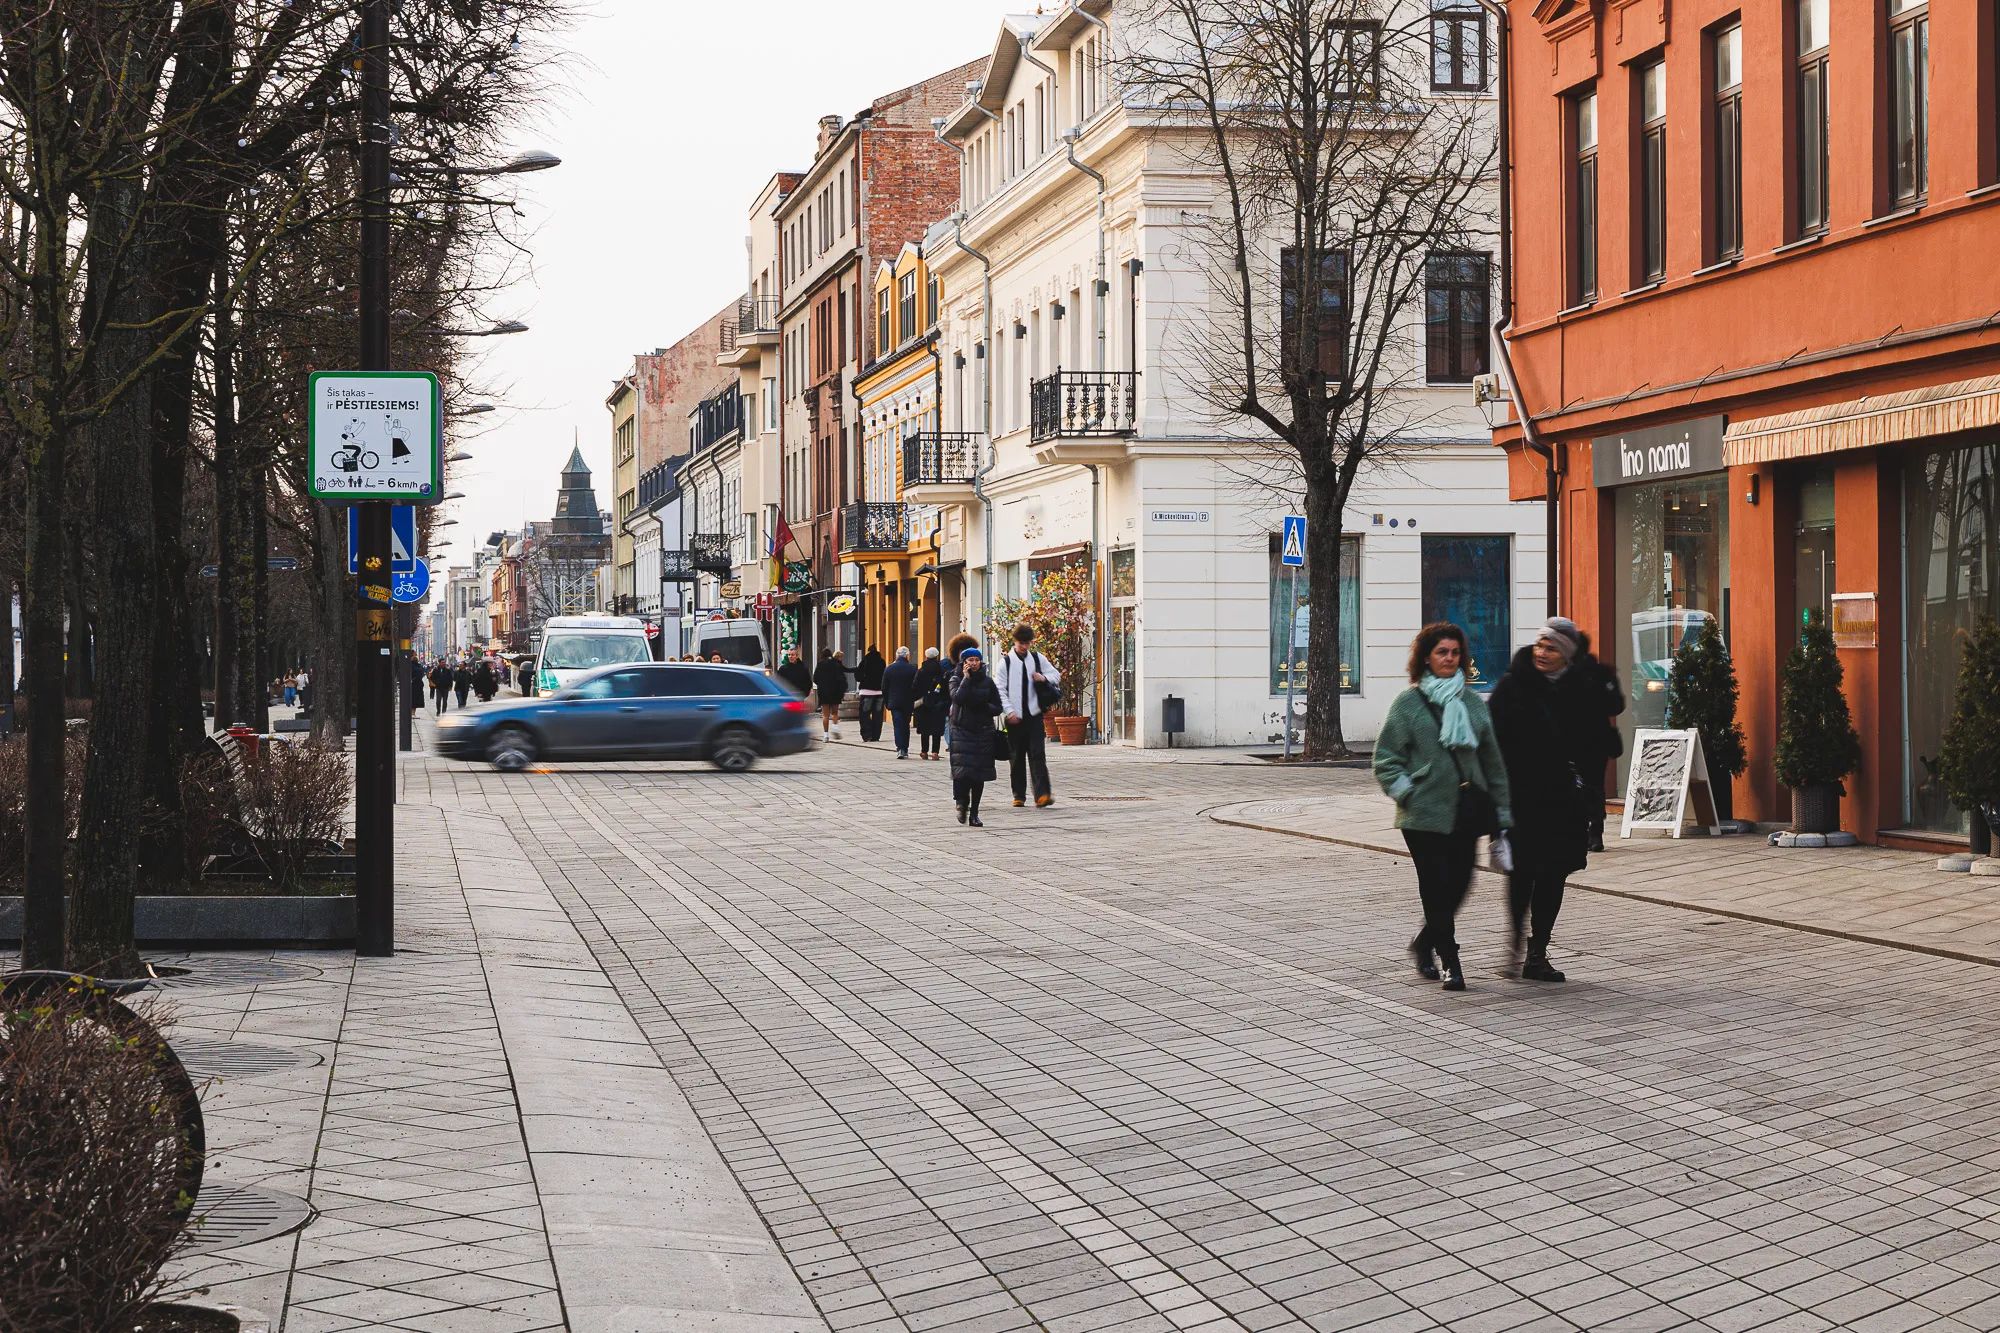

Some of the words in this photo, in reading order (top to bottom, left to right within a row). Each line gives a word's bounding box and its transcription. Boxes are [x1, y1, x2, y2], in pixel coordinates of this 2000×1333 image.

[327, 387, 340, 397] Šis
[342, 388, 366, 397] takas
[327, 401, 334, 410] ir
[335, 397, 419, 410] PĖSTIESIEMS!
[1620, 438, 1644, 478] lino
[1648, 432, 1691, 474] namai
[387, 477, 396, 488] 6
[397, 479, 418, 489] km/h
